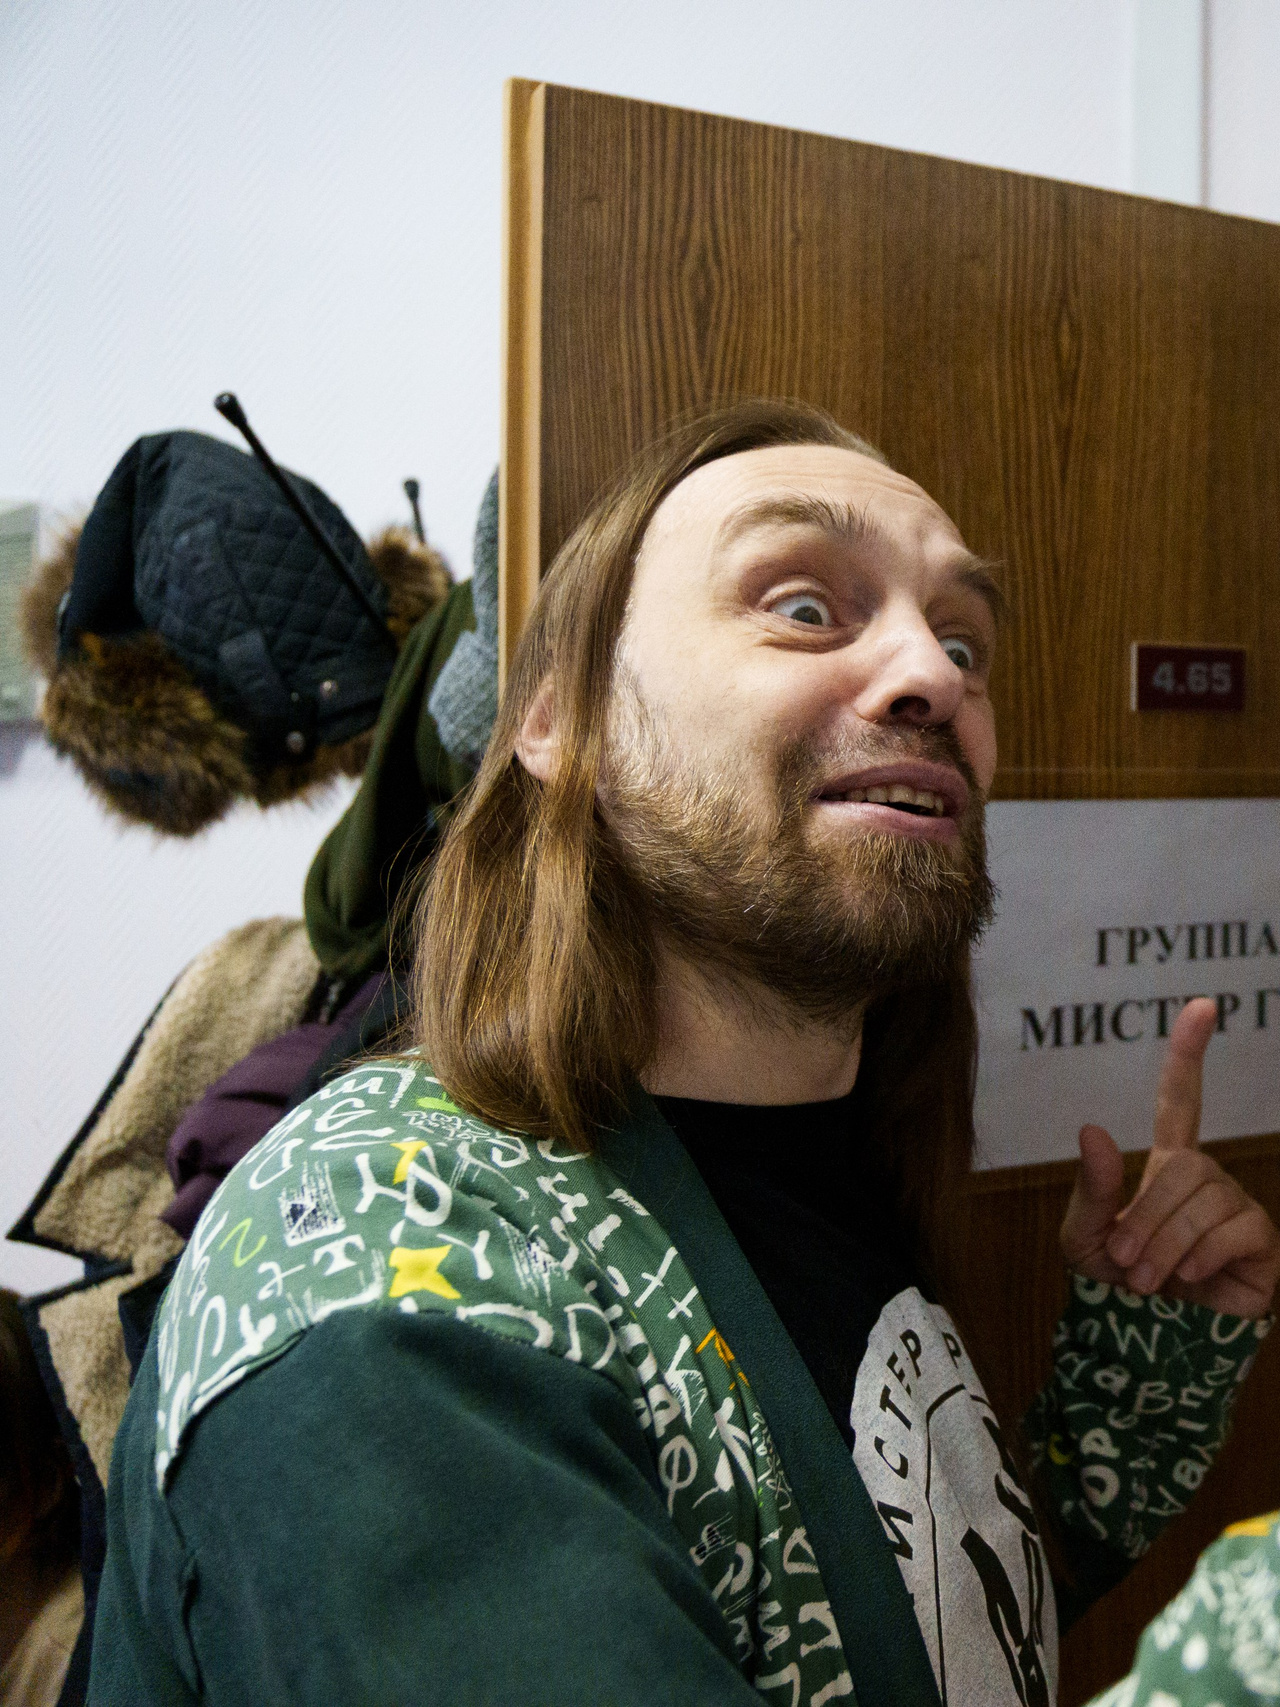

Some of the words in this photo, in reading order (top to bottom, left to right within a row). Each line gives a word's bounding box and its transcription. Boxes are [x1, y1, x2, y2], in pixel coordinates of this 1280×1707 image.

[1152, 661, 1232, 694] 4.65
[1096, 920, 1280, 967] ГРУППА
[1019, 993, 1242, 1051] МИСТР
[874, 1328, 922, 1600] ИСТЕР
